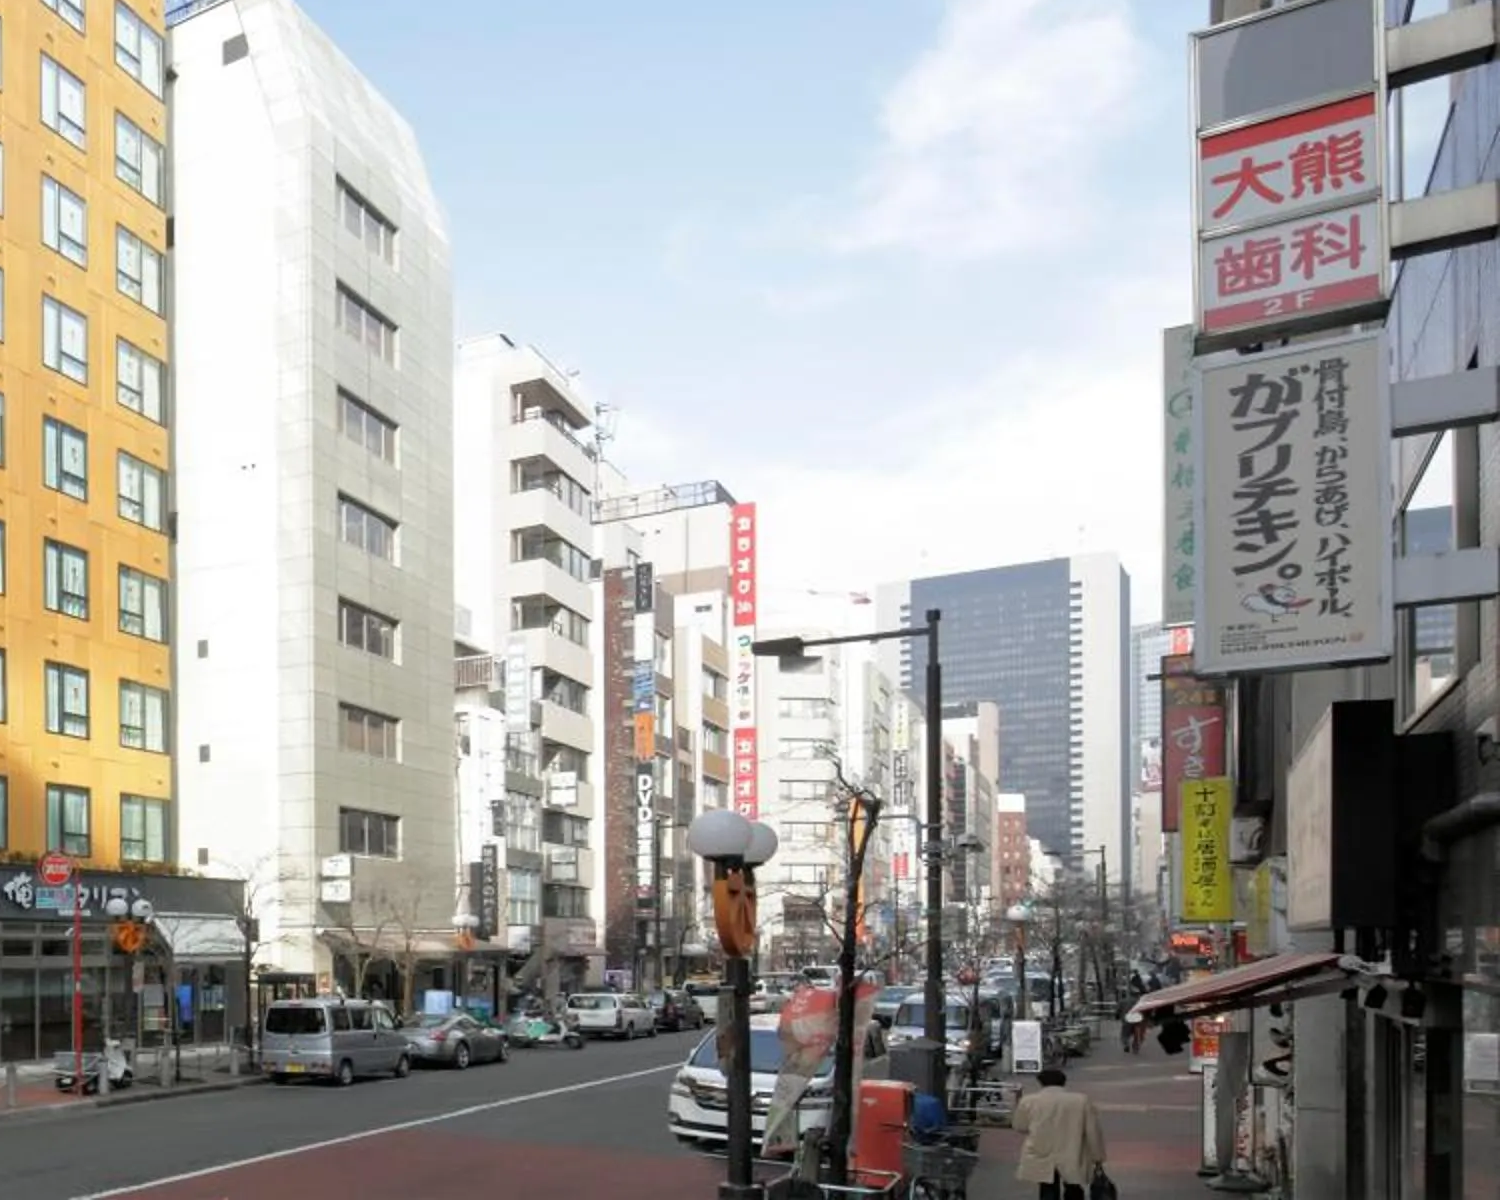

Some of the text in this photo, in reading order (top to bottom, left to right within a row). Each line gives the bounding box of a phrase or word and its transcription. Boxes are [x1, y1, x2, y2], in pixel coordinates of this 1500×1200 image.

[1210, 130, 1366, 218] 大熊
[1213, 213, 1367, 298] 歯科
[637, 775, 653, 822] DVD
